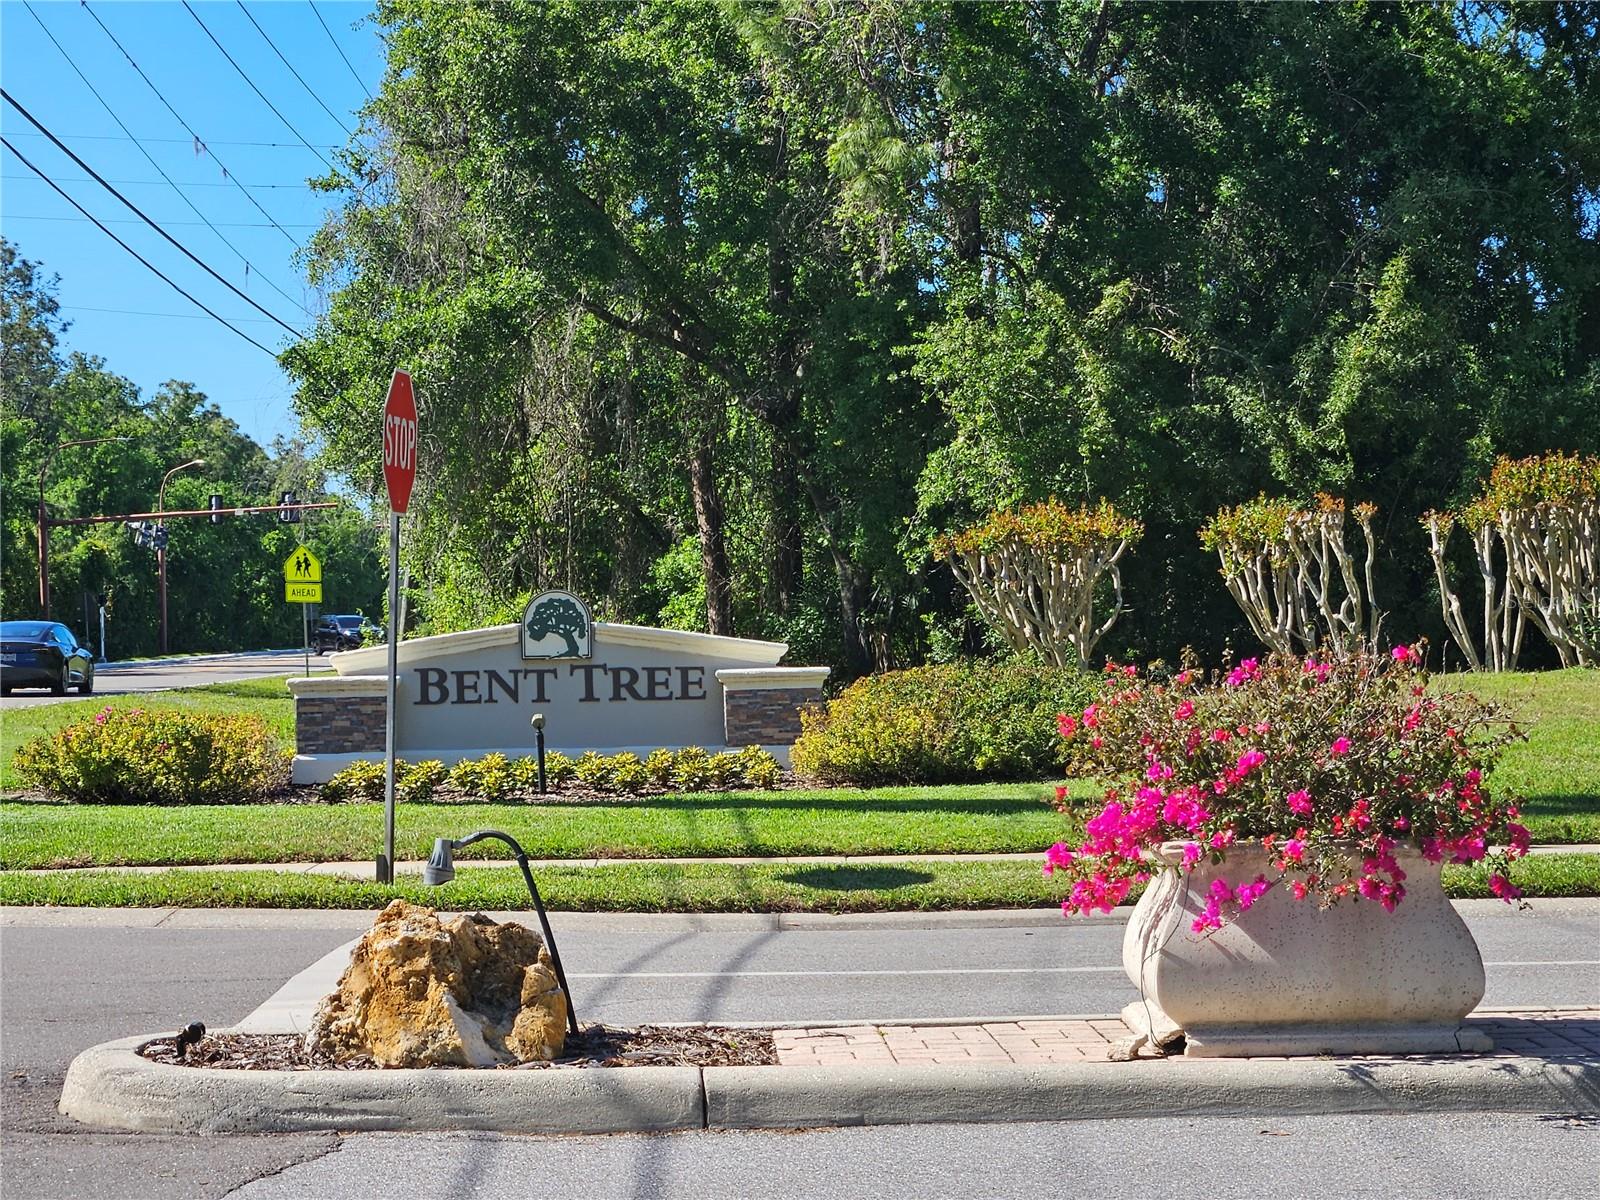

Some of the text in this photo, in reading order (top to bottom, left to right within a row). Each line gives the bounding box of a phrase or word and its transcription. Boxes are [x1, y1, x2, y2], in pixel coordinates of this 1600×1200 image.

[385, 414, 415, 470] STOP
[292, 588, 316, 597] AHEAD
[413, 663, 706, 705] BENT TREE
